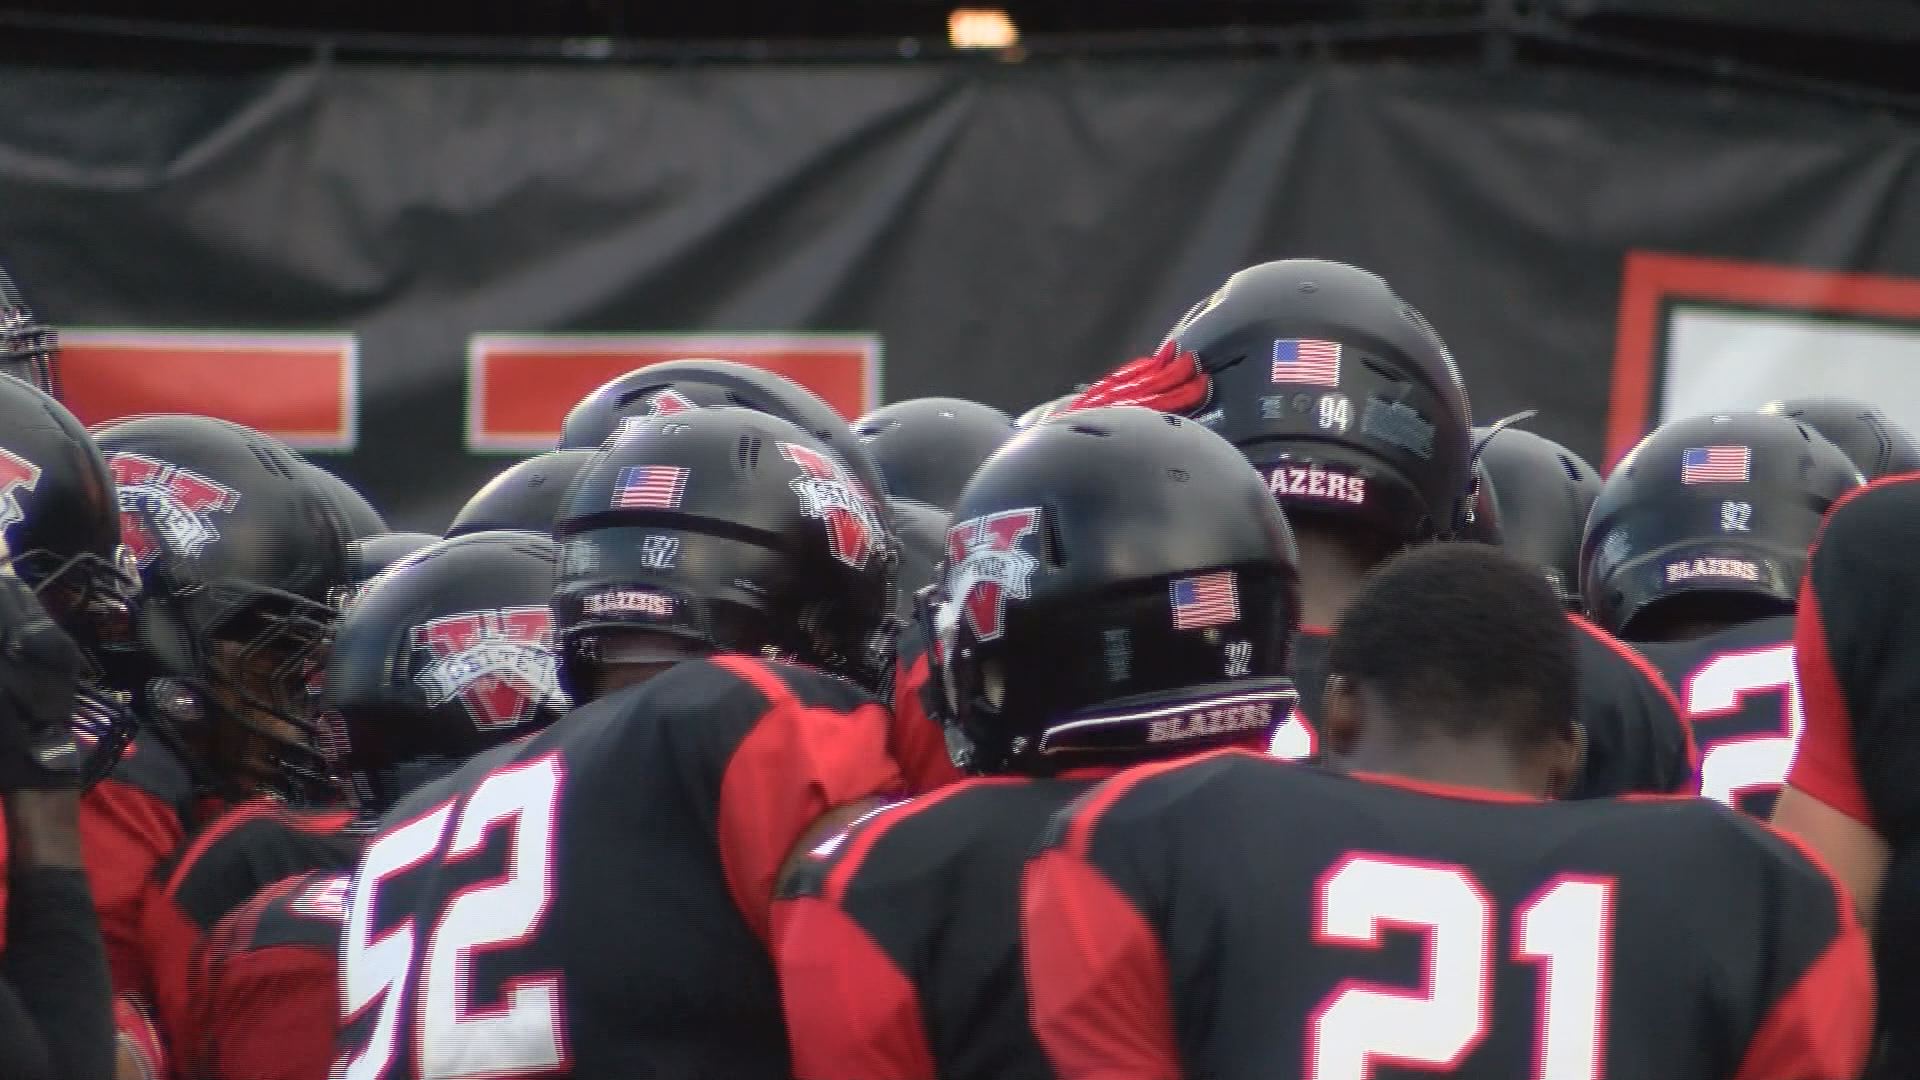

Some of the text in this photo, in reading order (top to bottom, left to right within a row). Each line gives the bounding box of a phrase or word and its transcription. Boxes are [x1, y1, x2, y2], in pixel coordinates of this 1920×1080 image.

[1319, 396, 1349, 430] 94
[1264, 466, 1365, 504] AZERS
[1721, 501, 1752, 531] 92
[641, 535, 680, 569] 52
[1666, 558, 1759, 582] BLAZERS
[583, 591, 673, 615] BLAZERS
[1224, 641, 1252, 676] 32
[1147, 703, 1272, 742] BLAZERS
[326, 751, 569, 1080] 52
[1307, 849, 1617, 1080] 21
